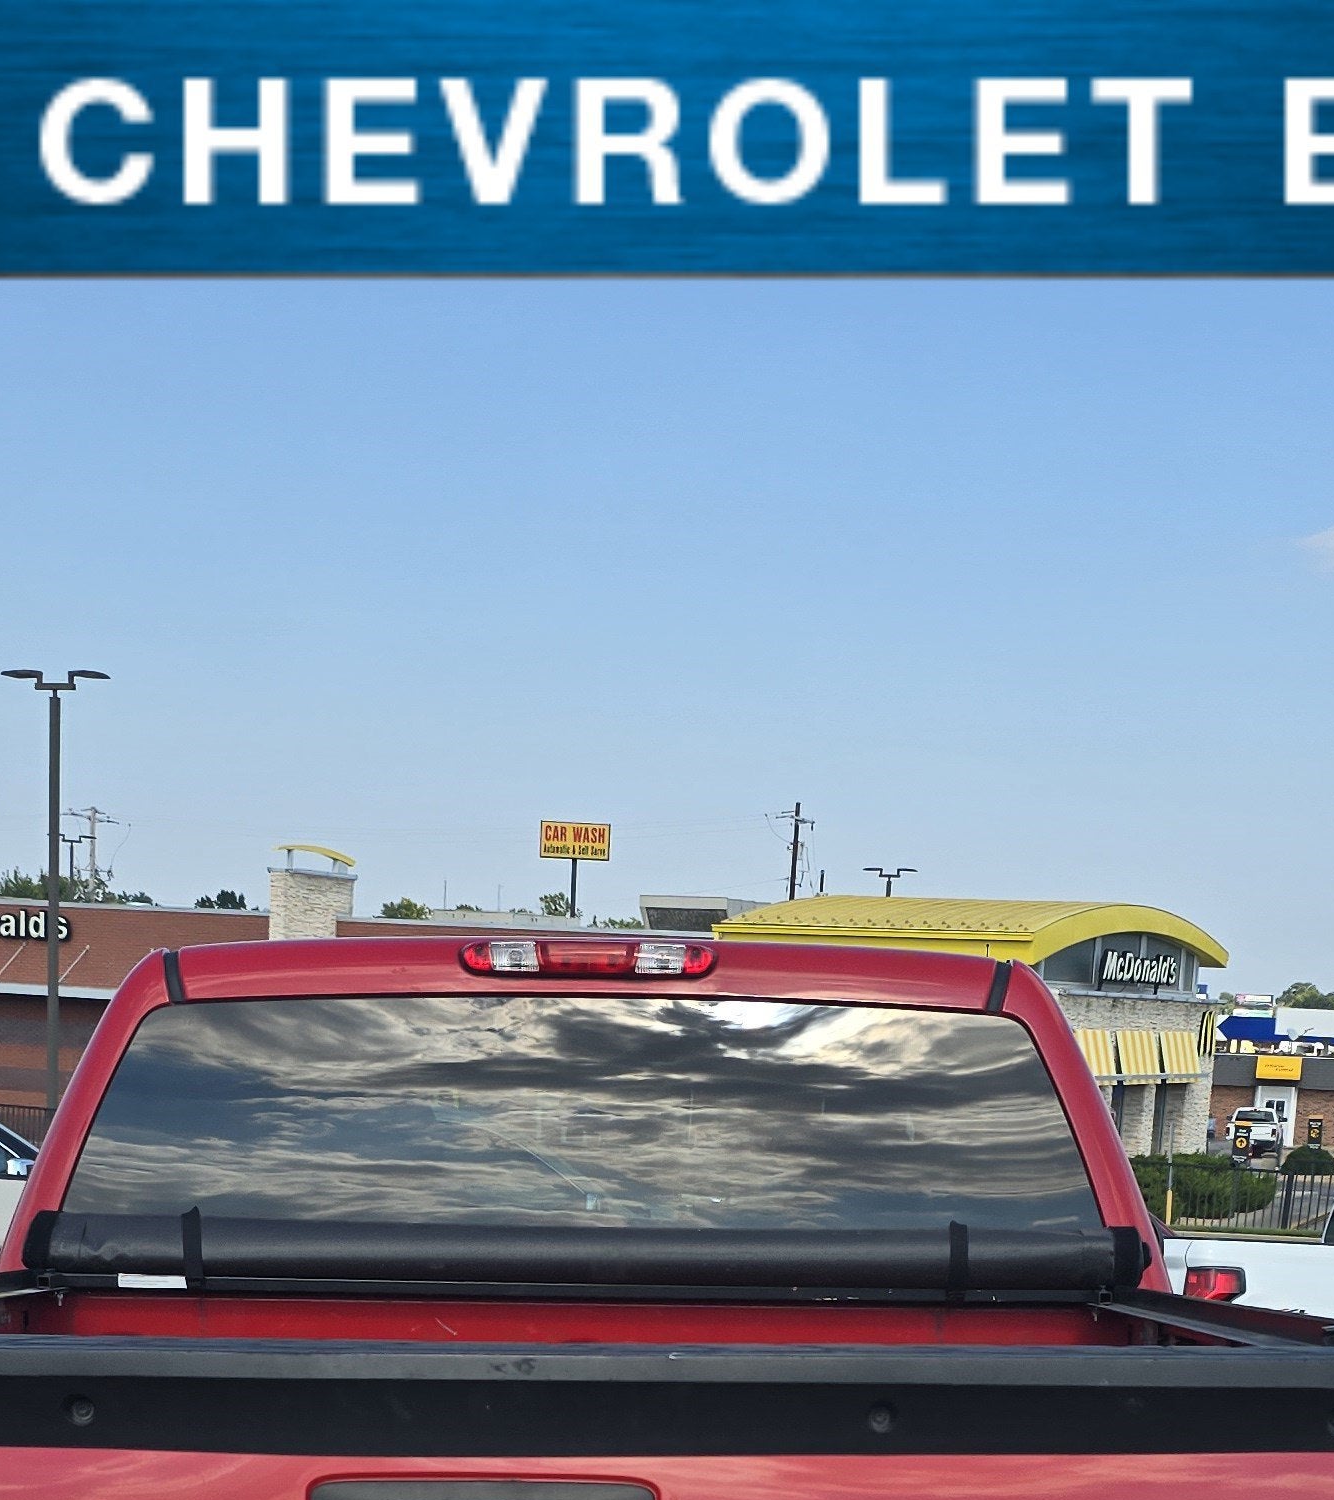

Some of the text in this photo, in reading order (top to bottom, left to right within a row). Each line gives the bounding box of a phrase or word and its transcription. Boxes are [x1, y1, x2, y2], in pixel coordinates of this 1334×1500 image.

[545, 825, 606, 844] CAR WASH
[1102, 950, 1177, 985] McDonald's
